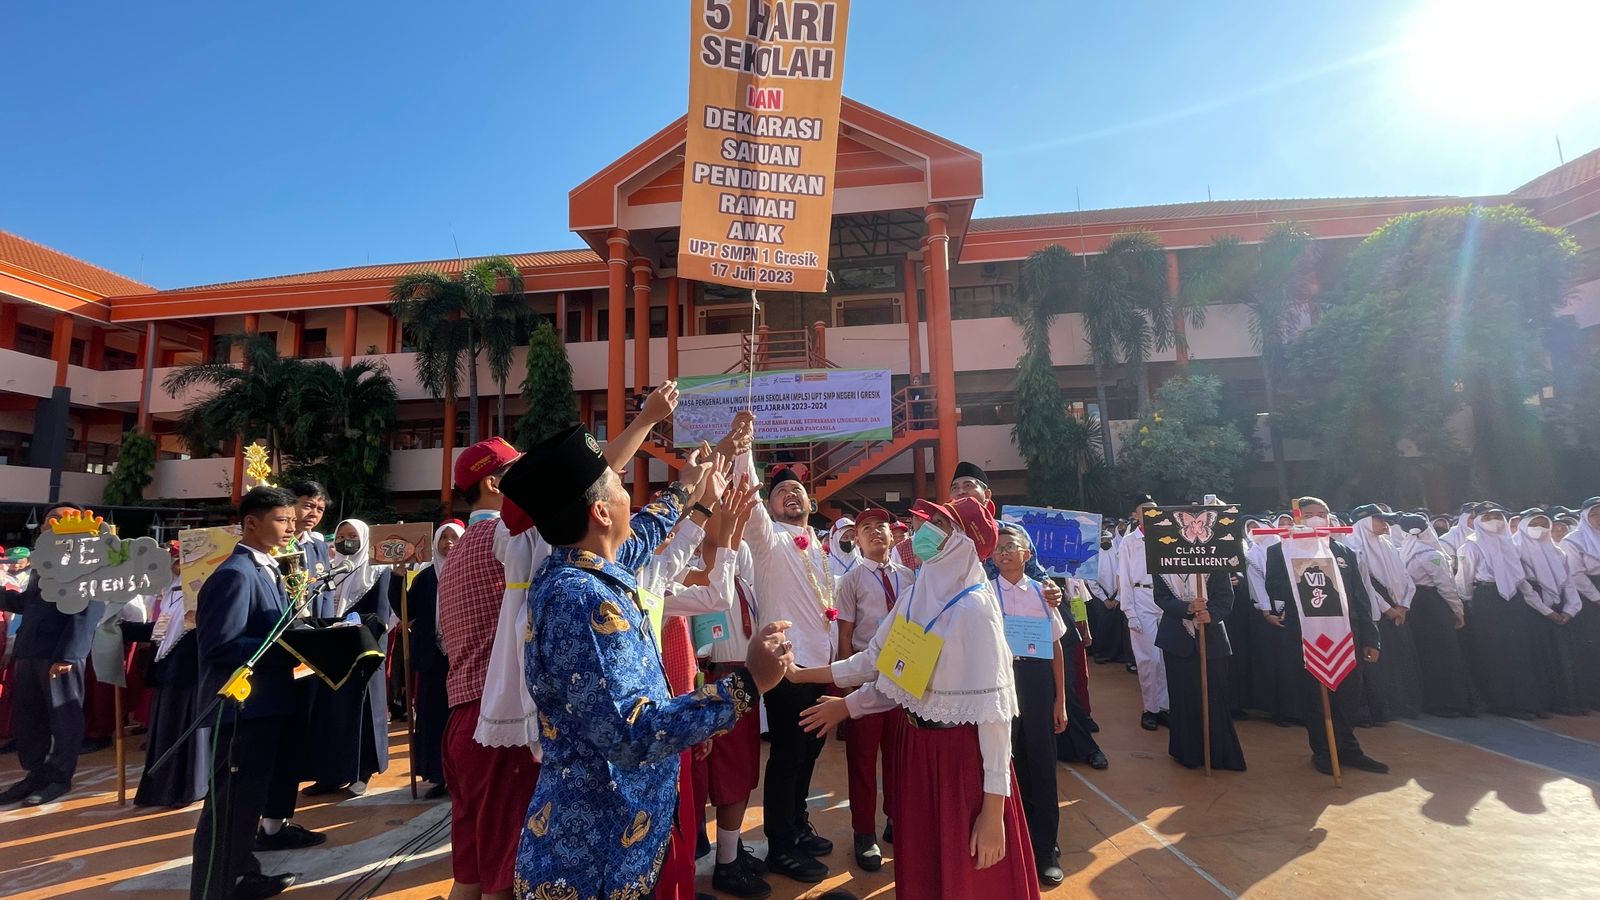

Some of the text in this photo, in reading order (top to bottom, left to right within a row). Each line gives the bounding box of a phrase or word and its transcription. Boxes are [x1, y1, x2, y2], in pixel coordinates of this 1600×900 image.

[704, 0, 836, 44] 5 HARI
[701, 33, 835, 81] SEKOLAH
[747, 85, 784, 111] DAN
[704, 105, 823, 141] DEKLARASI
[721, 137, 801, 166] SATUAN
[693, 162, 825, 196] PENDIDIKAN
[719, 192, 796, 220] RAMAH
[727, 220, 784, 244] ANAK
[689, 238, 818, 267] UPT SMPN 1 Gresik
[711, 262, 793, 284] 17 Juli 2023
[695, 398, 729, 406] PENGENALAN
[765, 393, 790, 402] SEKOLAH
[791, 392, 811, 400] (MPLS)
[811, 392, 822, 400] UPT
[824, 391, 835, 399] SMP
[836, 391, 856, 399] NEGERI
[860, 390, 881, 399] GRESIK
[752, 403, 790, 412] PELAJARAN
[792, 402, 827, 410] 2023-2024
[55, 536, 100, 565] 7E
[1160, 557, 1228, 566] INTELLIGENT
[1176, 546, 1217, 555] CLASS 7
[1304, 572, 1325, 586] VII
